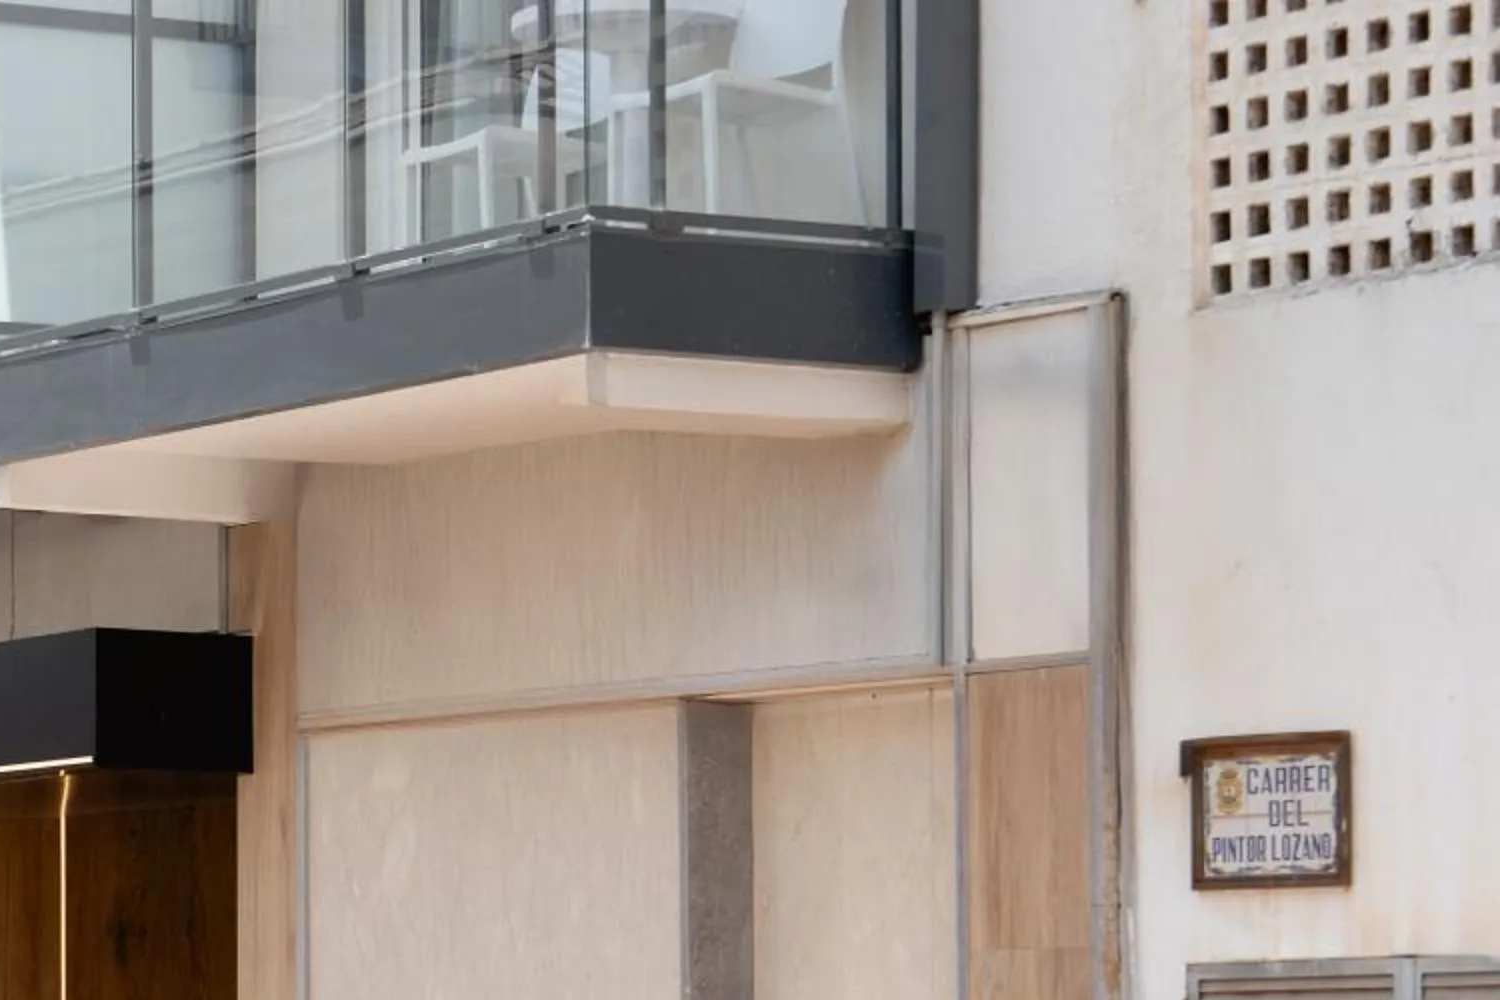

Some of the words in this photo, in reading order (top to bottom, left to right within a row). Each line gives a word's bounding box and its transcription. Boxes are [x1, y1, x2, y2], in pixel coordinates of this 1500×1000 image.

[1246, 765, 1330, 794] CARRER
[1268, 799, 1309, 827] DEL
[1211, 835, 1267, 863] PINTOR
[1271, 832, 1332, 861] LOZANO
